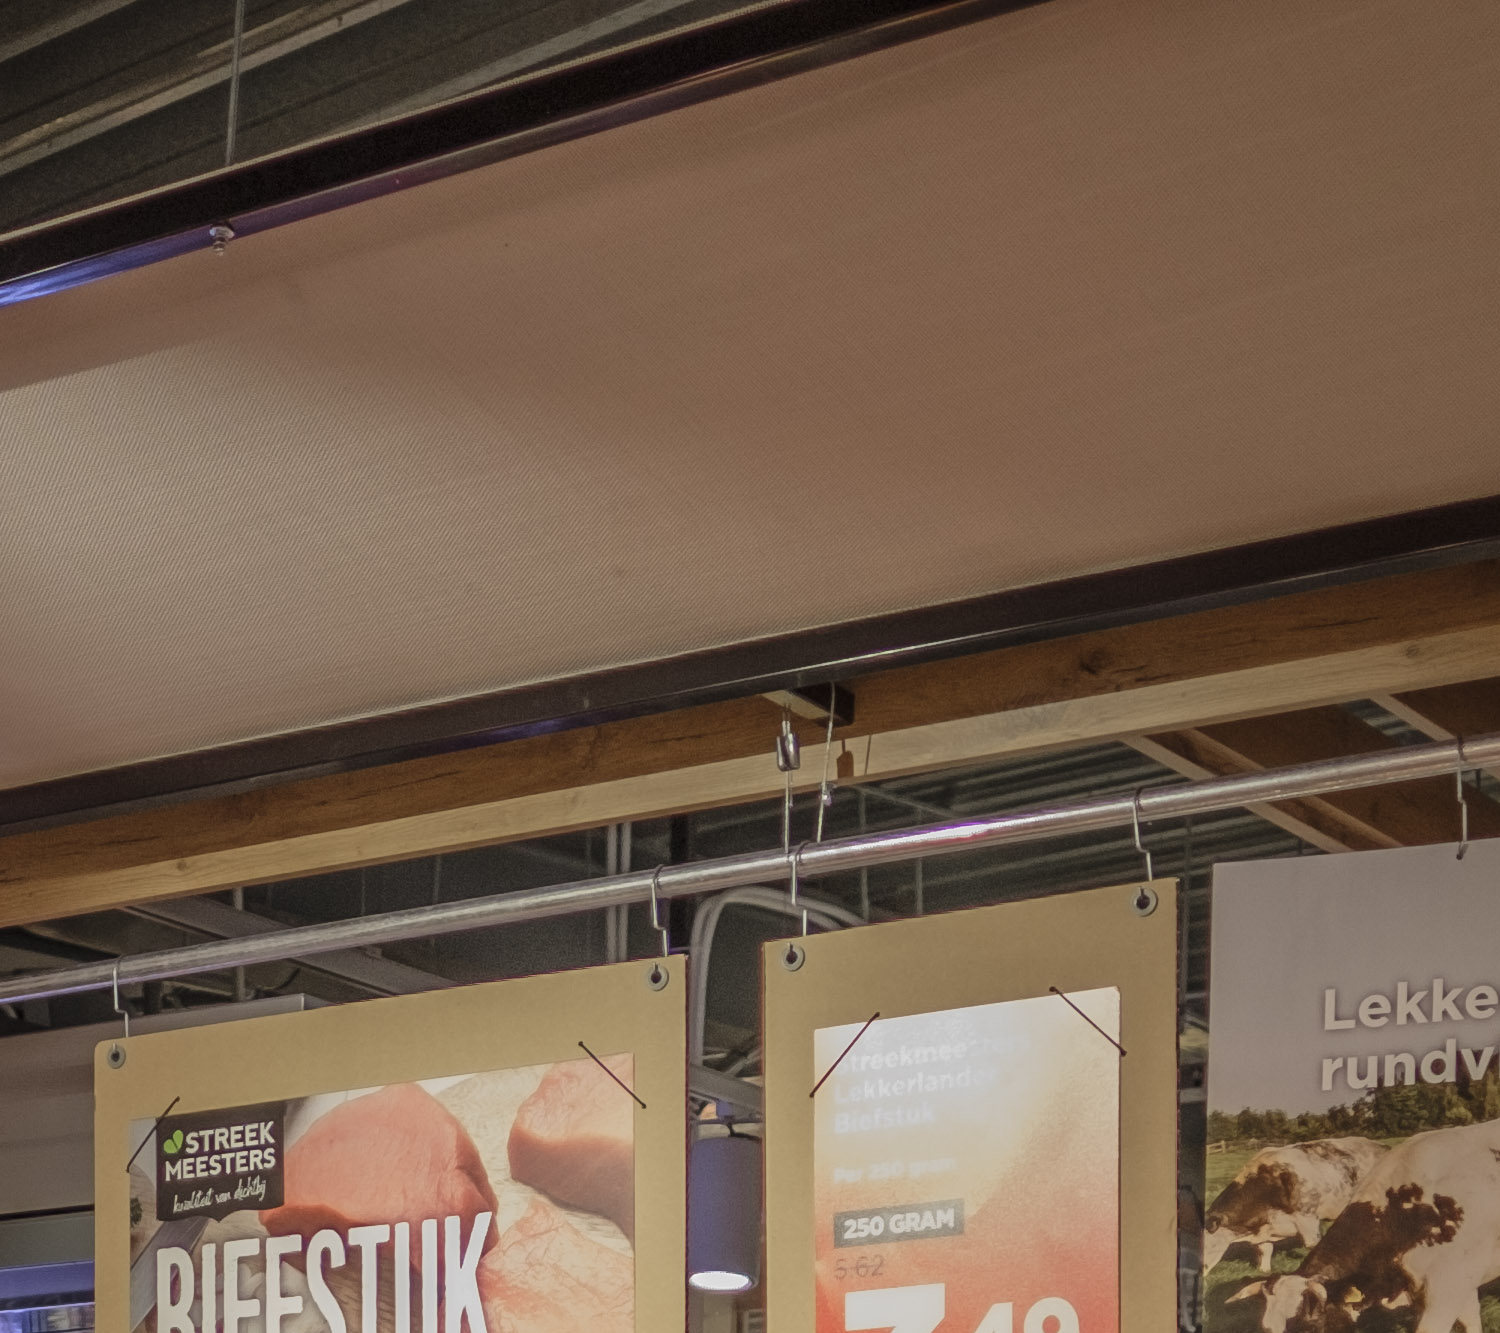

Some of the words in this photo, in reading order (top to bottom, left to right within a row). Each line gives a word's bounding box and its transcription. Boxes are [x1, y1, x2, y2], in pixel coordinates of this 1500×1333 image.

[185, 1121, 275, 1154] STREEK
[165, 1147, 276, 1181] MEESTERS
[844, 1216, 884, 1240] 250
[889, 1208, 955, 1234] GRAM
